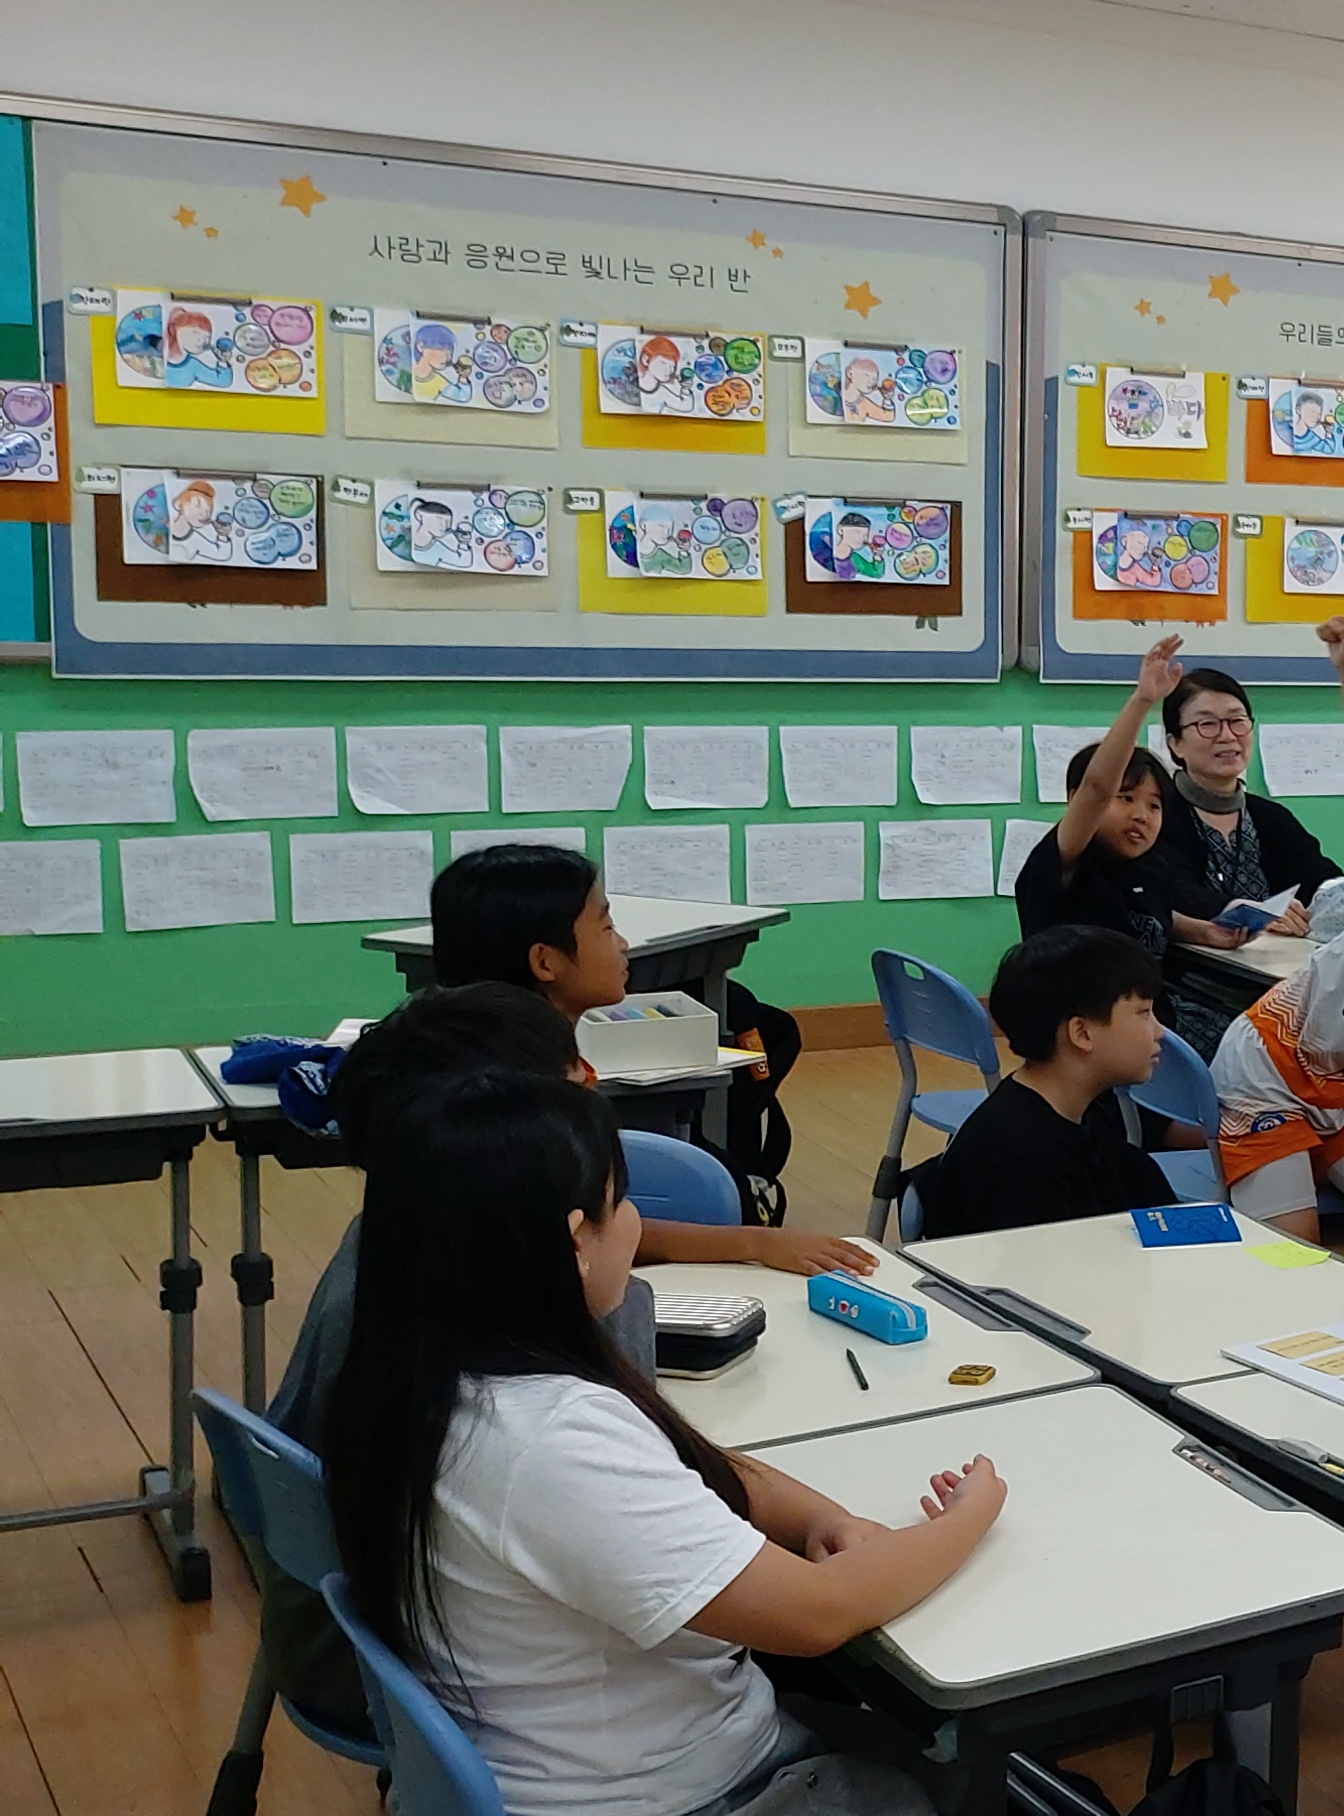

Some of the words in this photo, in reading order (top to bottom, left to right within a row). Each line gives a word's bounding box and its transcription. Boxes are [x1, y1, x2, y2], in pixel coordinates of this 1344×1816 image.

[368, 234, 451, 266] 사랑과
[464, 243, 569, 276] 응원으로
[582, 254, 655, 285] 빛나는
[668, 263, 715, 290] 우리
[728, 268, 751, 293] 반
